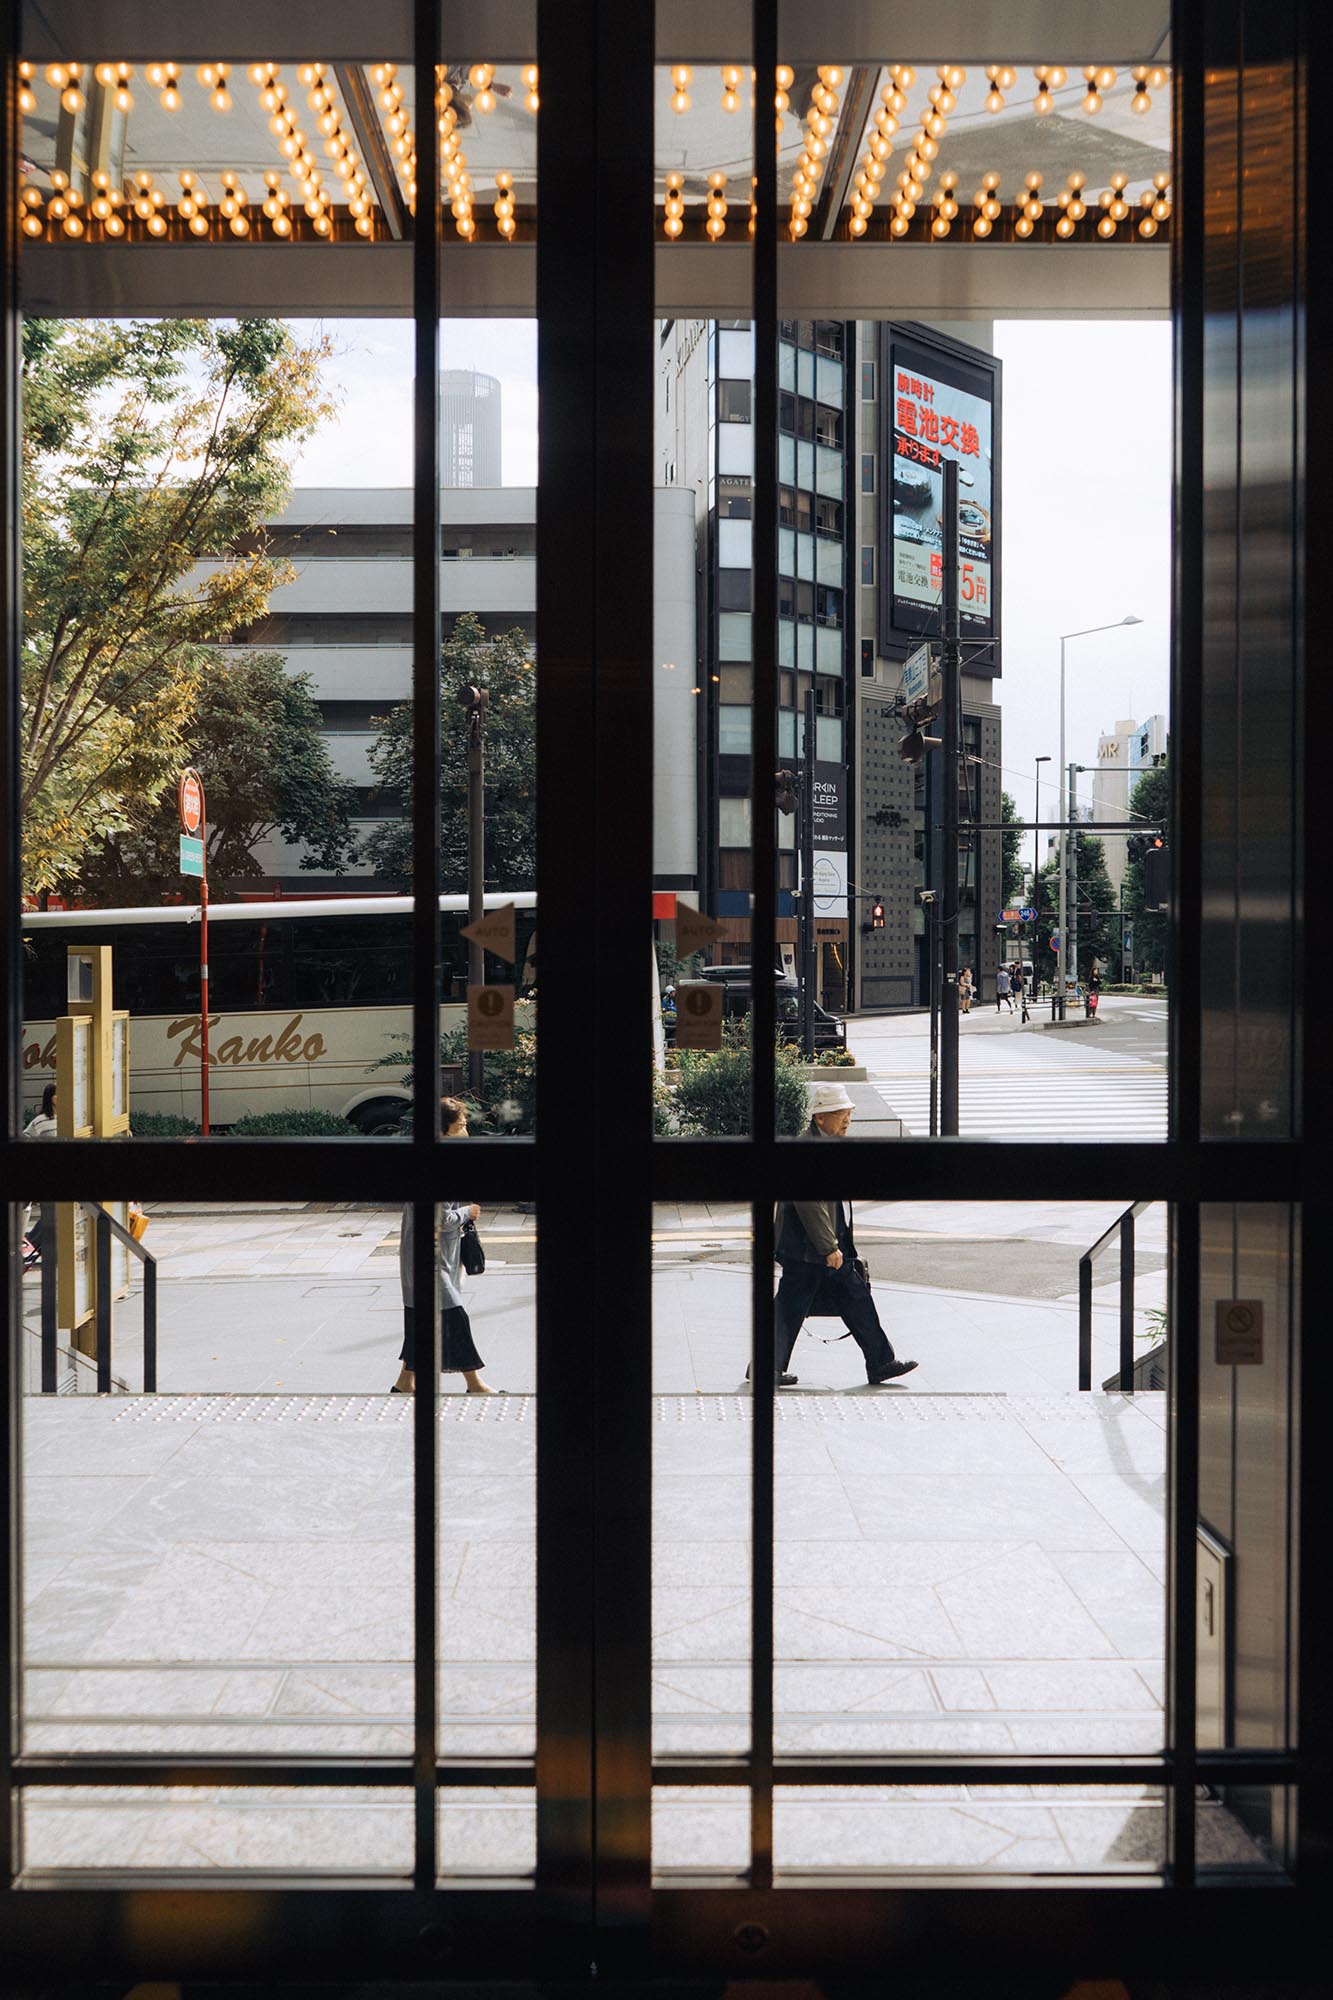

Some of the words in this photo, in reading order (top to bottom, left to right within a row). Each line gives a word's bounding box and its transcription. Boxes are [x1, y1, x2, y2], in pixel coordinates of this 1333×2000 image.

[896, 371, 934, 404] 腕時計
[896, 396, 980, 459] 電池交換
[896, 436, 943, 468] 承ります
[897, 570, 930, 589] 電池交換
[475, 926, 509, 938] AUTO
[166, 1014, 327, 1067] Kanko
